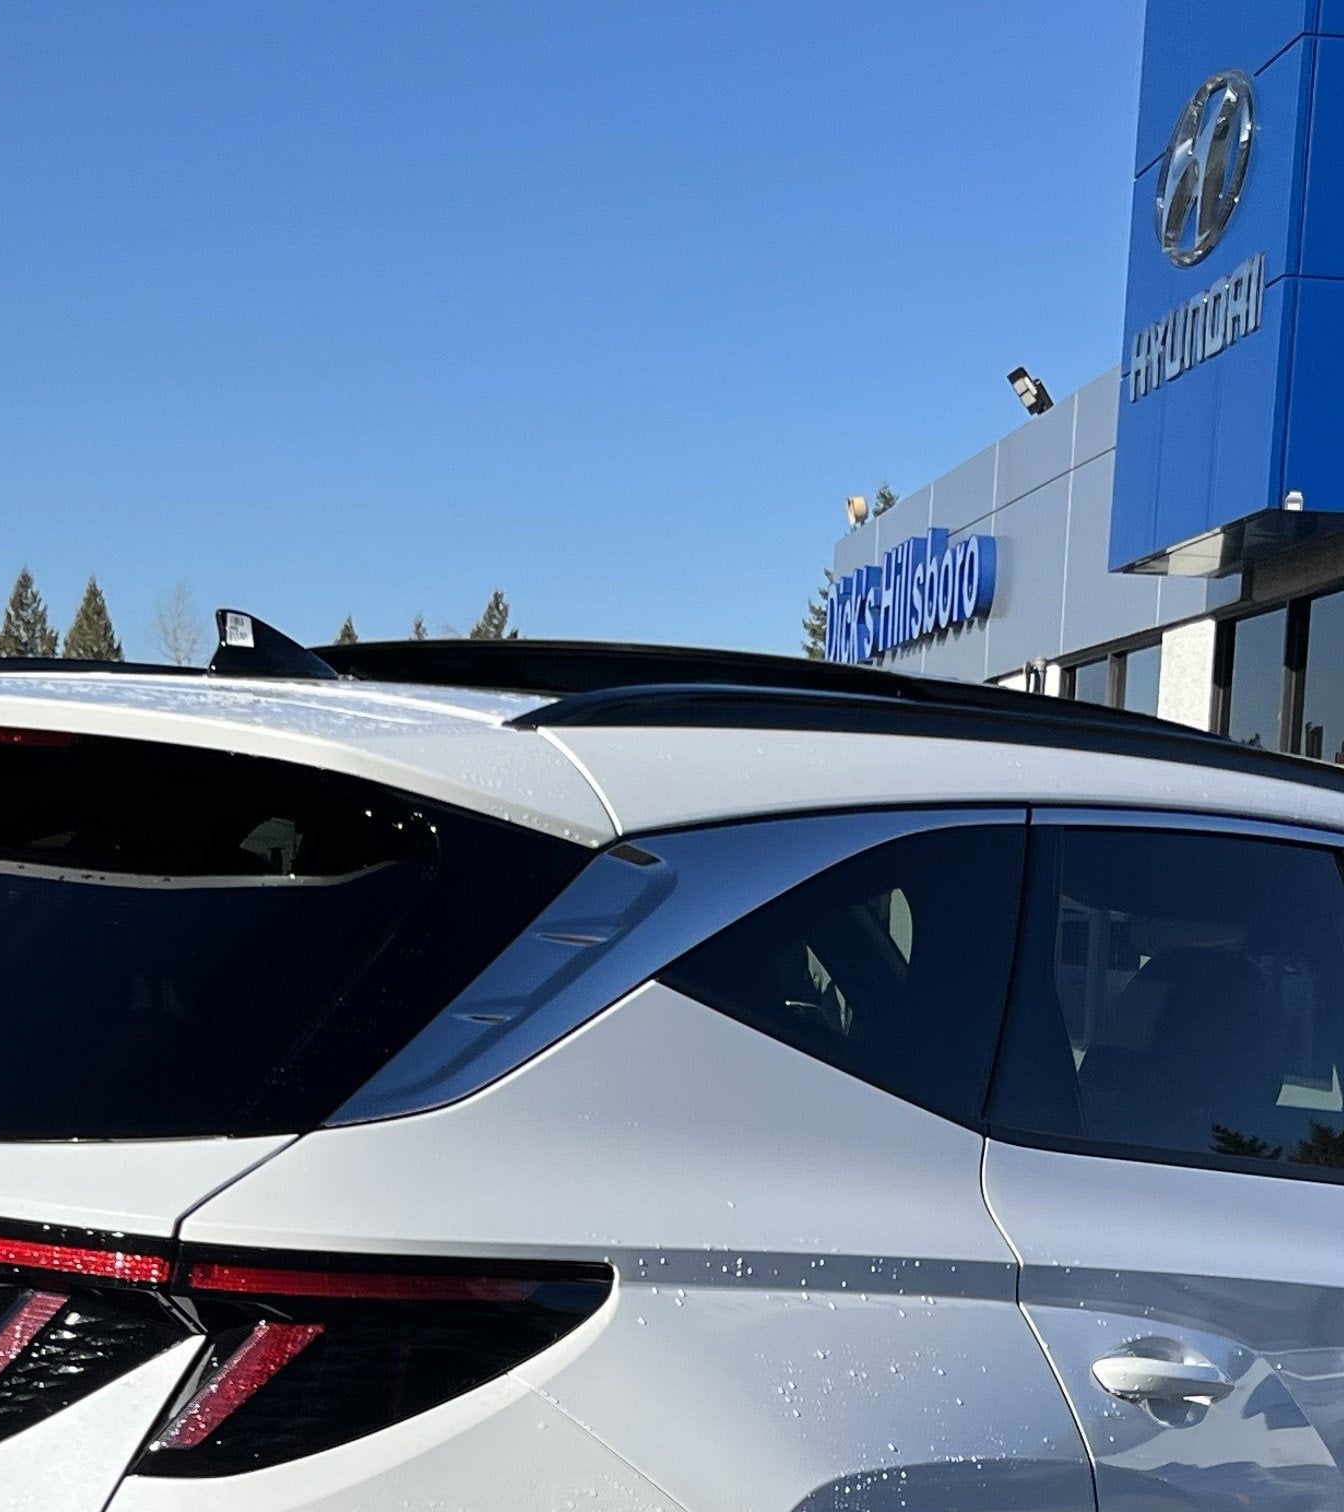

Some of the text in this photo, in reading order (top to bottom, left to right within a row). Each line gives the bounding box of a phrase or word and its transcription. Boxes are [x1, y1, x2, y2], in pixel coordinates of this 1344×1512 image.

[1129, 252, 1265, 403] HYUNDAI
[825, 527, 982, 664] Dick's Hillsboro
